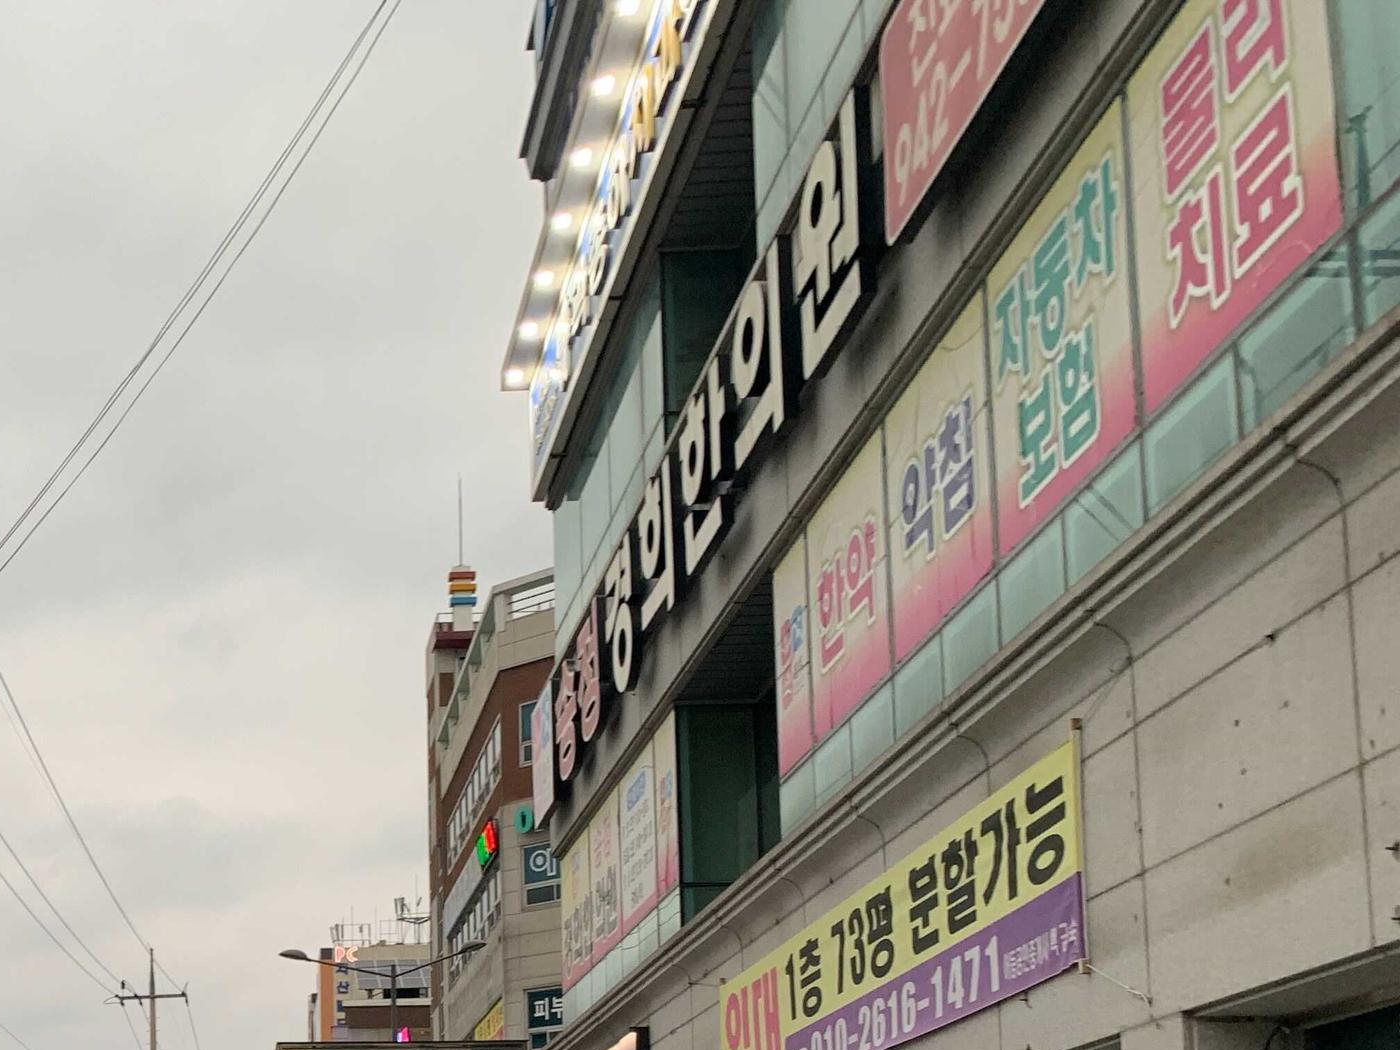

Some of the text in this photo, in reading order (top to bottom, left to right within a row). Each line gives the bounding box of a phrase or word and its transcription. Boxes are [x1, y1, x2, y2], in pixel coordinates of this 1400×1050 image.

[1161, 0, 1288, 198] 물리
[1168, 88, 1302, 323] 치료
[996, 157, 1117, 388] 자동차
[555, 598, 601, 782] 송정
[604, 84, 862, 694] 경희한의원
[903, 393, 976, 558] 약침
[1021, 318, 1097, 505] 보험
[816, 516, 877, 673] 한약
[785, 776, 1067, 1020] 1층 73평 분할가능
